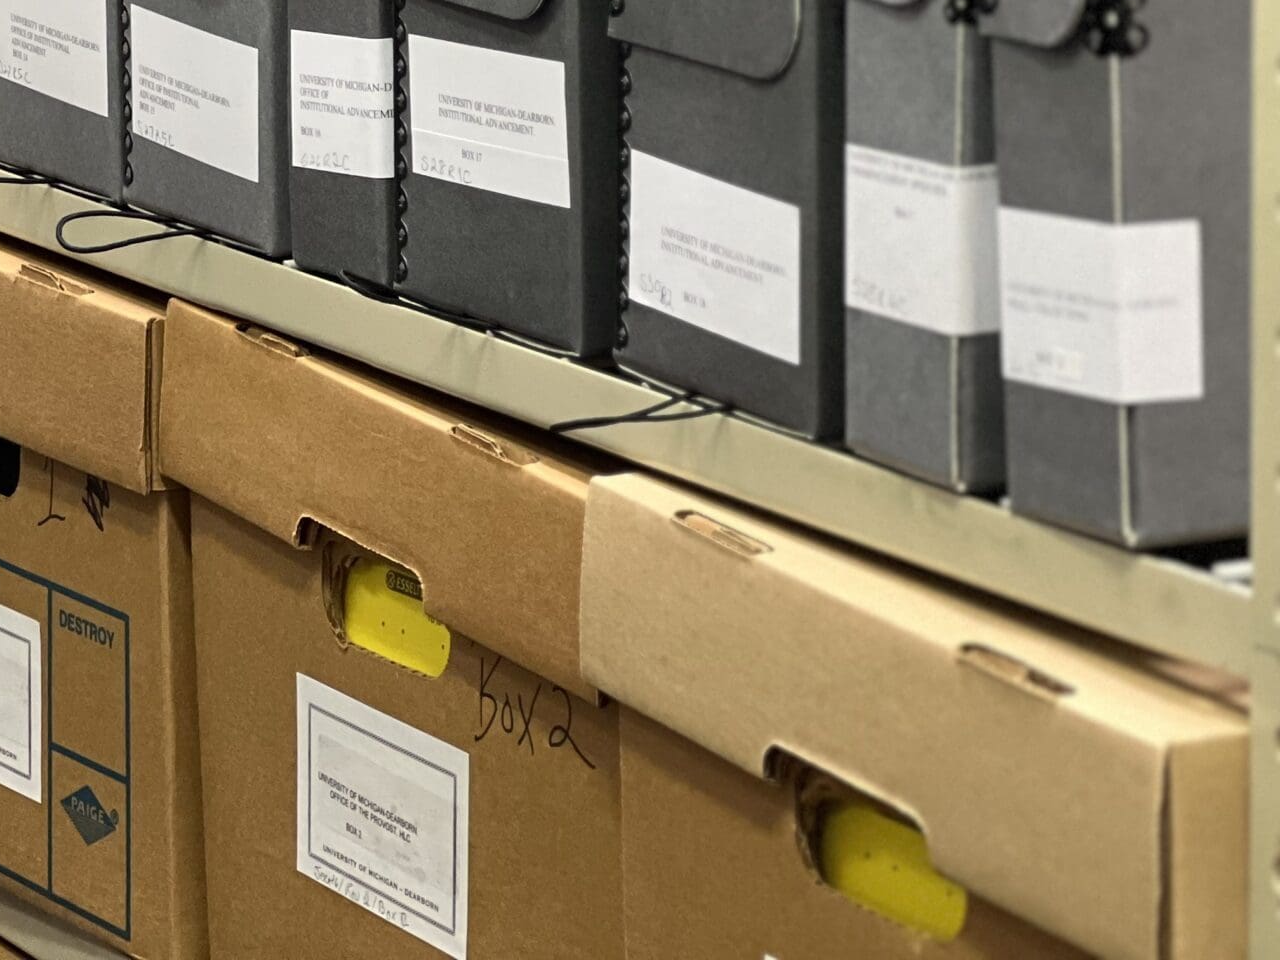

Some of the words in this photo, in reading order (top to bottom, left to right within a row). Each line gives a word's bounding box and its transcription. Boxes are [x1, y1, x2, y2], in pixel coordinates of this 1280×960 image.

[10, 12, 37, 30] UNIVERSITY
[38, 23, 45, 32] OF
[10, 25, 26, 38] OFFICE
[27, 31, 33, 40] OF
[34, 34, 70, 55] INSTITUTIONAL
[139, 64, 167, 82] UNIVERSITY
[167, 76, 174, 86] OF
[139, 76, 155, 90] OFFICE
[155, 83, 162, 93] OF
[299, 73, 335, 88] UNIVERSITY
[335, 78, 343, 89] OF
[300, 86, 320, 98] OFFICE
[321, 90, 329, 100] OF
[438, 93, 473, 110] UNIVERSITY
[474, 101, 482, 111] OF
[300, 100, 345, 115] INSTITUTIONAL
[438, 107, 484, 126] INSTITUTIONAL
[300, 126, 313, 136] BOX
[461, 148, 474, 161] BOX
[59, 609, 115, 649] DESTROY
[549, 683, 597, 770] 2
[71, 796, 105, 824] PAIGE
[318, 771, 349, 796] UNIVERSITY
[350, 789, 357, 799] OF
[358, 794, 418, 835] MICHIGAN-DEARBORN
[330, 789, 349, 808] OFFICE
[350, 801, 357, 811] OF
[358, 806, 369, 820] THE
[399, 831, 411, 844] HLC
[345, 822, 358, 837] BOX
[323, 843, 357, 868] UNIVERSITY
[358, 864, 367, 873] OF
[368, 869, 398, 891] MICHIGAN
[404, 887, 439, 913] DEARBORN
